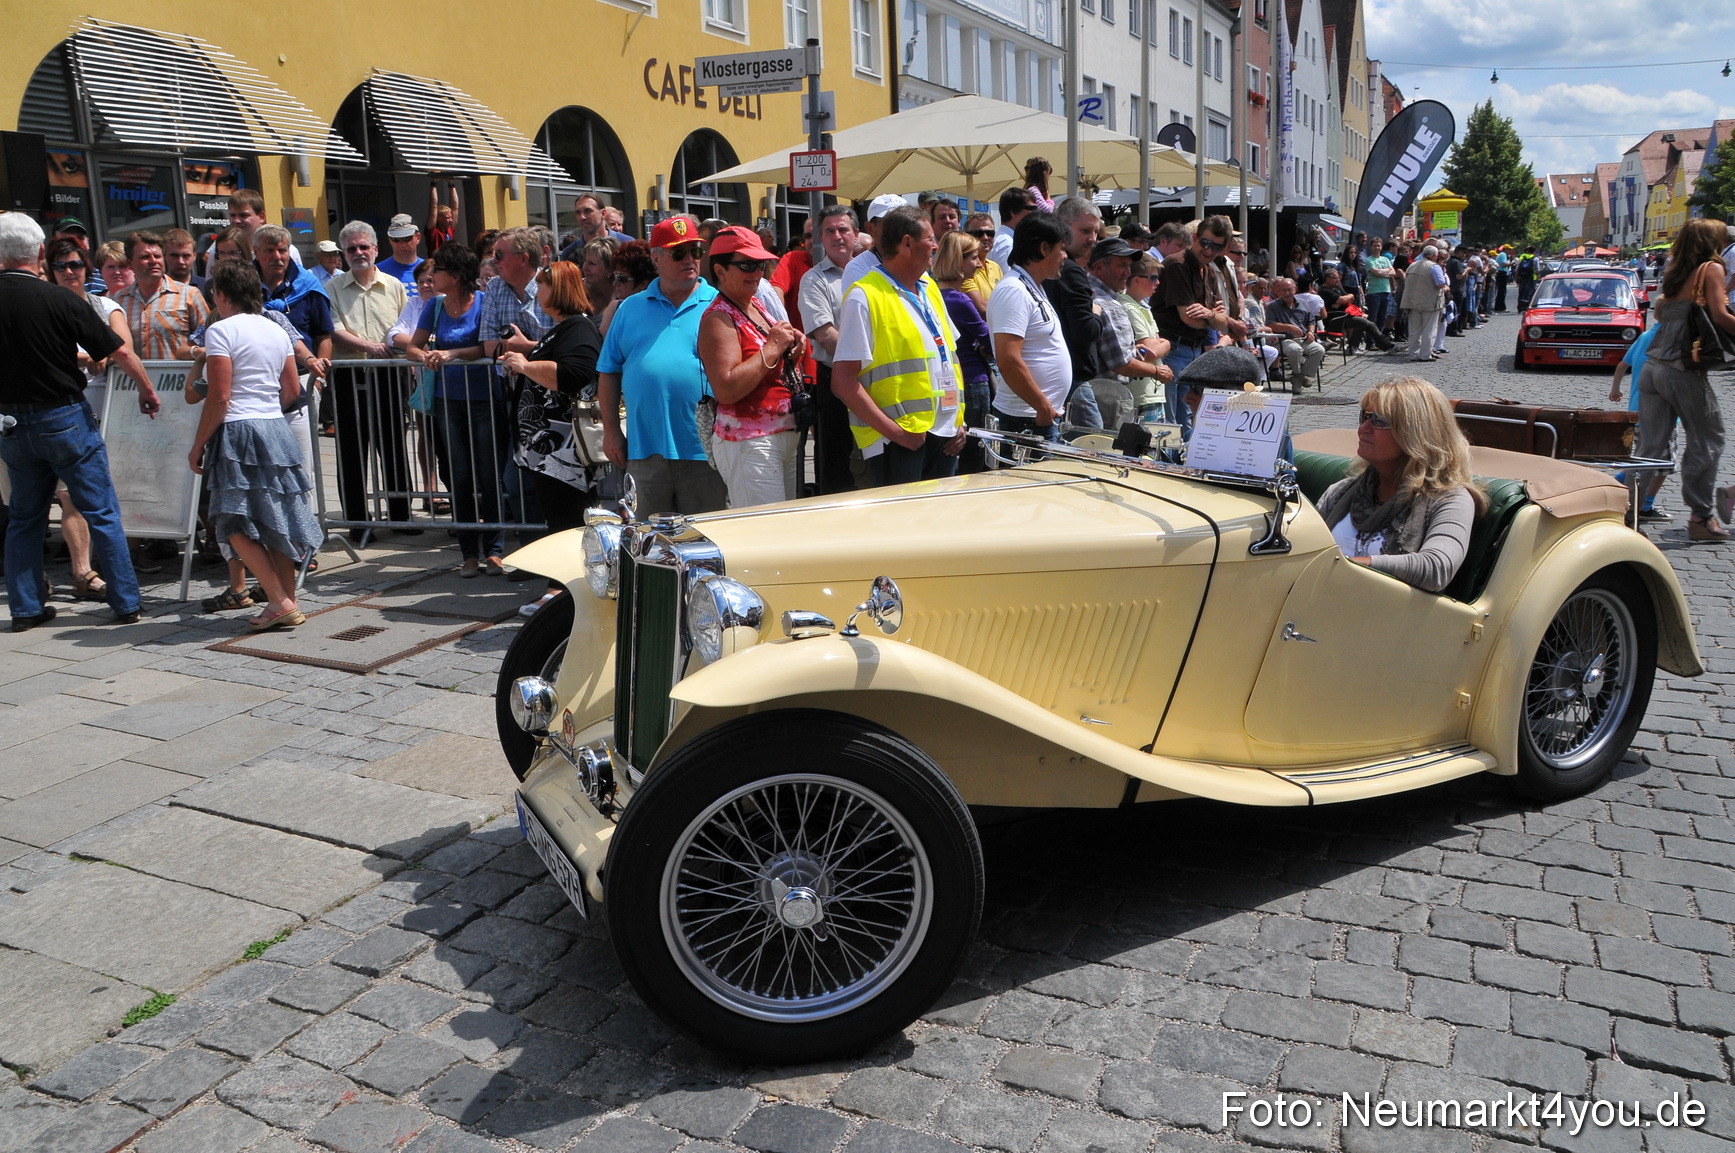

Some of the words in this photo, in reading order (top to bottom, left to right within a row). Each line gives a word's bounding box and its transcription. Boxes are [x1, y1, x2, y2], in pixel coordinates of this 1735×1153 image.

[702, 57, 794, 79] Klostergasse
[644, 58, 707, 109] CAFE
[795, 156, 802, 166] H
[807, 155, 824, 165] 200
[820, 167, 832, 177] 0,2
[1367, 124, 1442, 219] THULE
[55, 194, 81, 204] Bilder
[109, 183, 168, 203] hailer
[1235, 410, 1275, 435] 200
